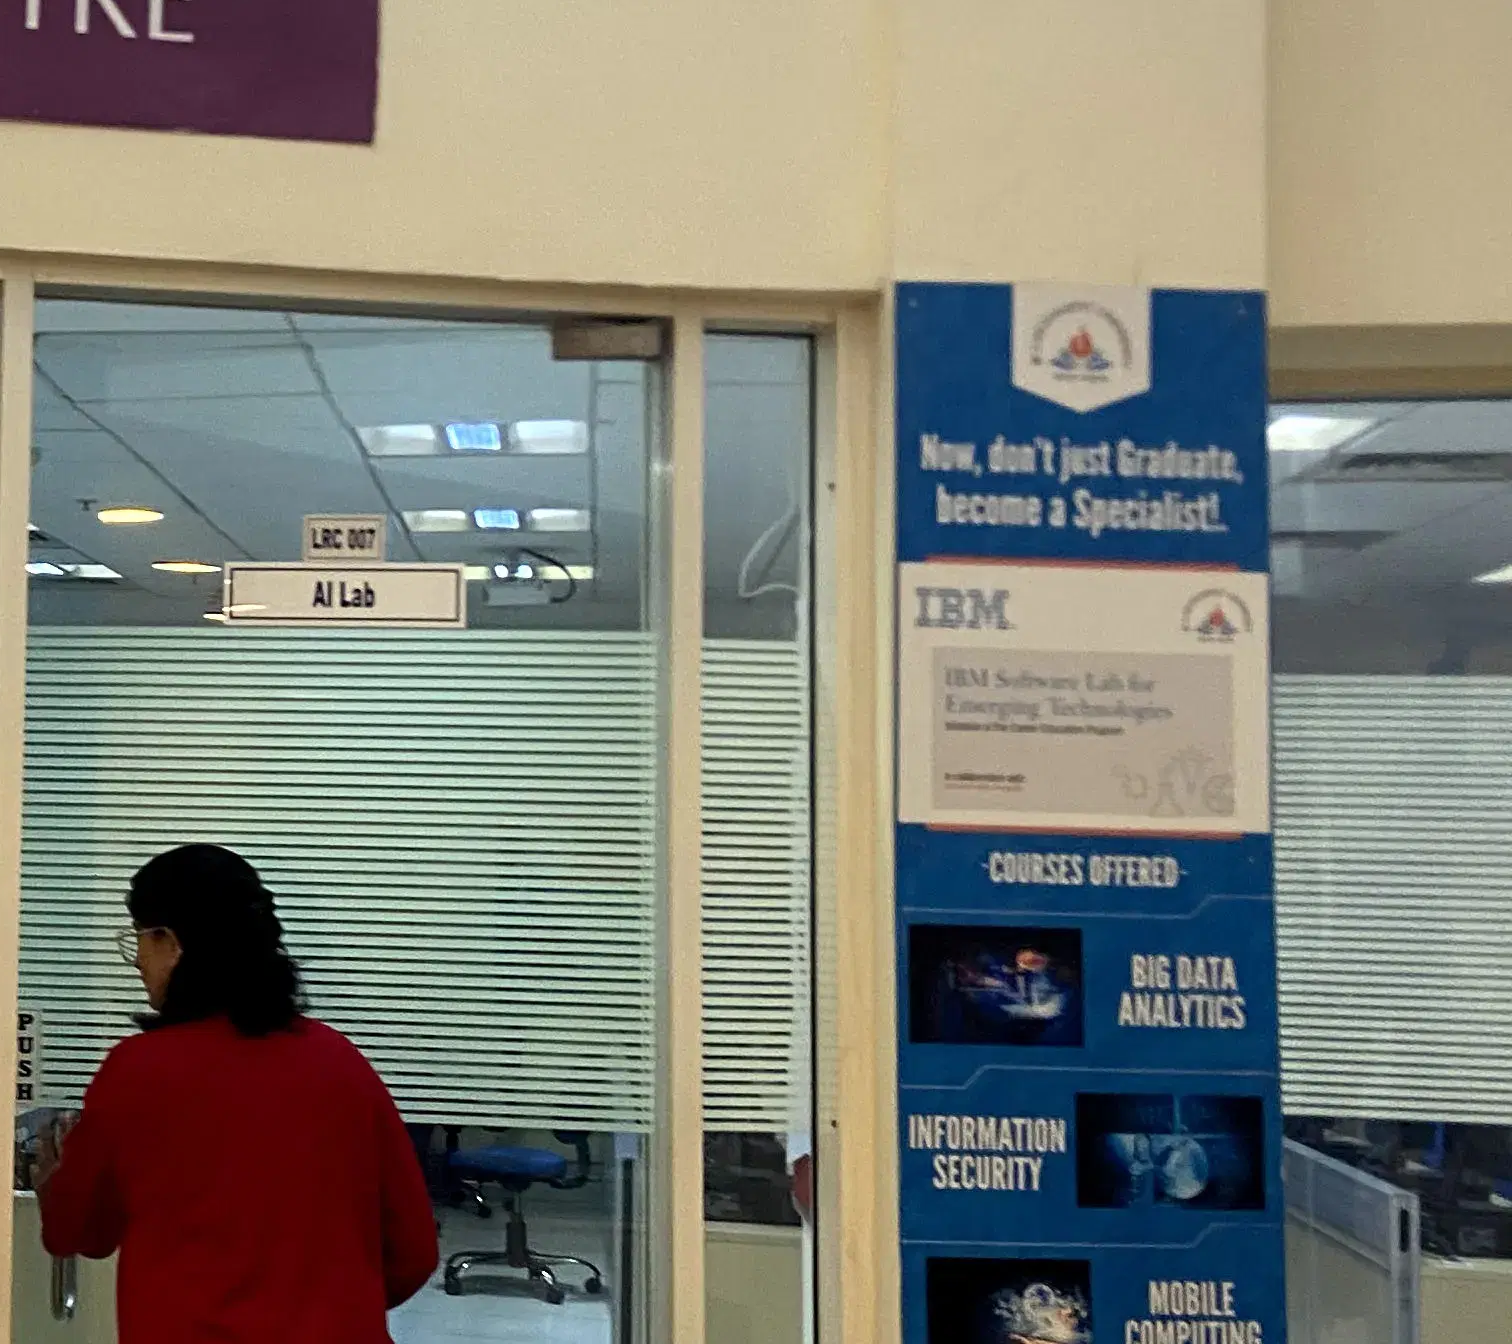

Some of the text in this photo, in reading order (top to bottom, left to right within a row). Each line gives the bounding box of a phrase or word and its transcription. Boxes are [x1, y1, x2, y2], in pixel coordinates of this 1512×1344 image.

[920, 434, 1244, 485] Now, don't just Graduate,
[936, 483, 1042, 527] become
[1047, 497, 1067, 528] a
[312, 527, 376, 550] LRC 007
[312, 581, 376, 608] AI Lab
[915, 586, 1011, 630] IBM
[944, 667, 989, 688] IBM
[988, 852, 1181, 888] COURSES OFFERED
[1131, 954, 1239, 991] BIG DATA
[1117, 993, 1247, 1030] ANALYTICS
[17, 1013, 34, 1101] PUSH
[908, 1114, 1068, 1154] INFORMATION
[932, 1154, 1043, 1191] SECURITY
[1147, 1280, 1236, 1317] MOBILE
